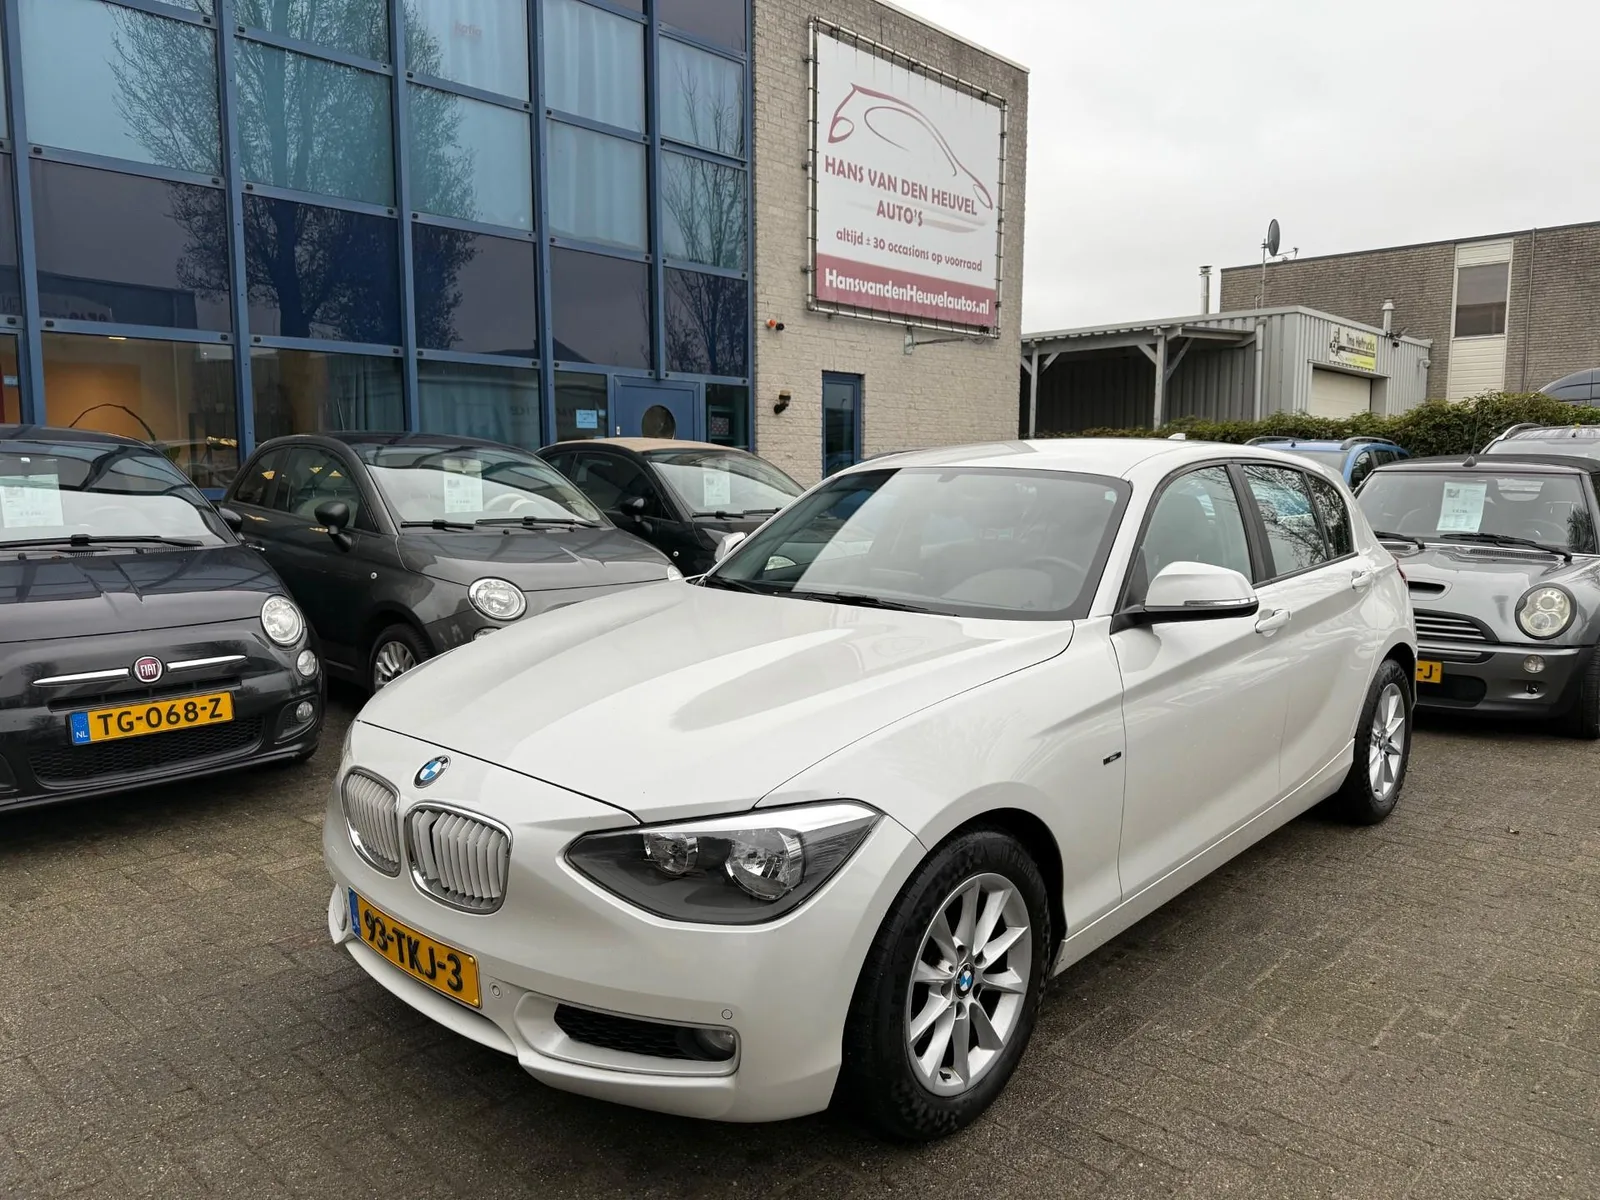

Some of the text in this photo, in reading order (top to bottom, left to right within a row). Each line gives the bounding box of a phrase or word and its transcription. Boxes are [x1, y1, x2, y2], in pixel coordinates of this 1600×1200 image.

[825, 155, 978, 216] HANS VAN DEN HEUVEL
[876, 200, 923, 227] AUTO'S
[836, 227, 864, 246] altijd
[873, 237, 886, 250] 30
[888, 242, 929, 260] occasions
[931, 252, 943, 265] op
[945, 255, 982, 272] voorraad
[825, 267, 990, 315] HansvandenHeuvelautos.nl
[140, 663, 157, 677] FIAT
[97, 697, 223, 736] TG-068-Z
[363, 908, 464, 992] 93-TKJ-3
